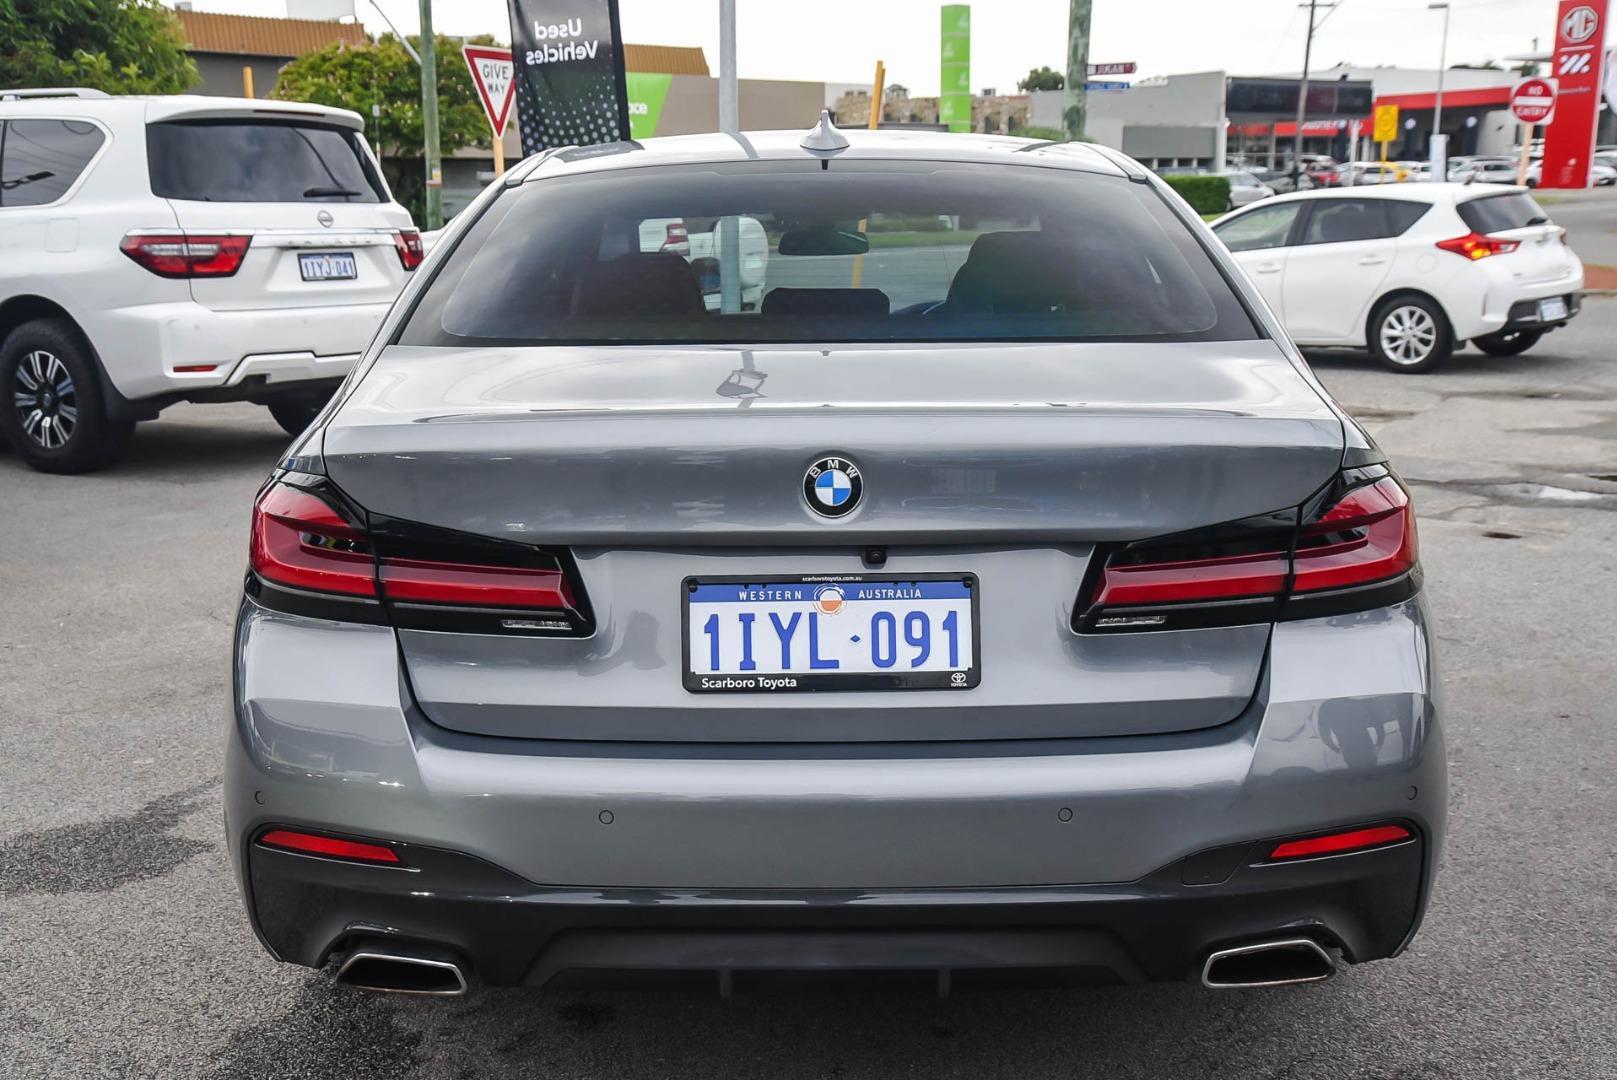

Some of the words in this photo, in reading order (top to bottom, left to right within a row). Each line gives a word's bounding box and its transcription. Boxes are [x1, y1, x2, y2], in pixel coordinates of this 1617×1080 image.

[1563, 8, 1596, 41] MG
[482, 64, 508, 80] GIVE
[487, 81, 505, 95] WAY
[1527, 86, 1543, 96] NO
[809, 459, 859, 479] BMW
[738, 590, 802, 601] WESTERN
[858, 588, 922, 599] AUSTRALIA
[701, 677, 756, 689] Scarboro
[758, 677, 798, 690] Toyota
